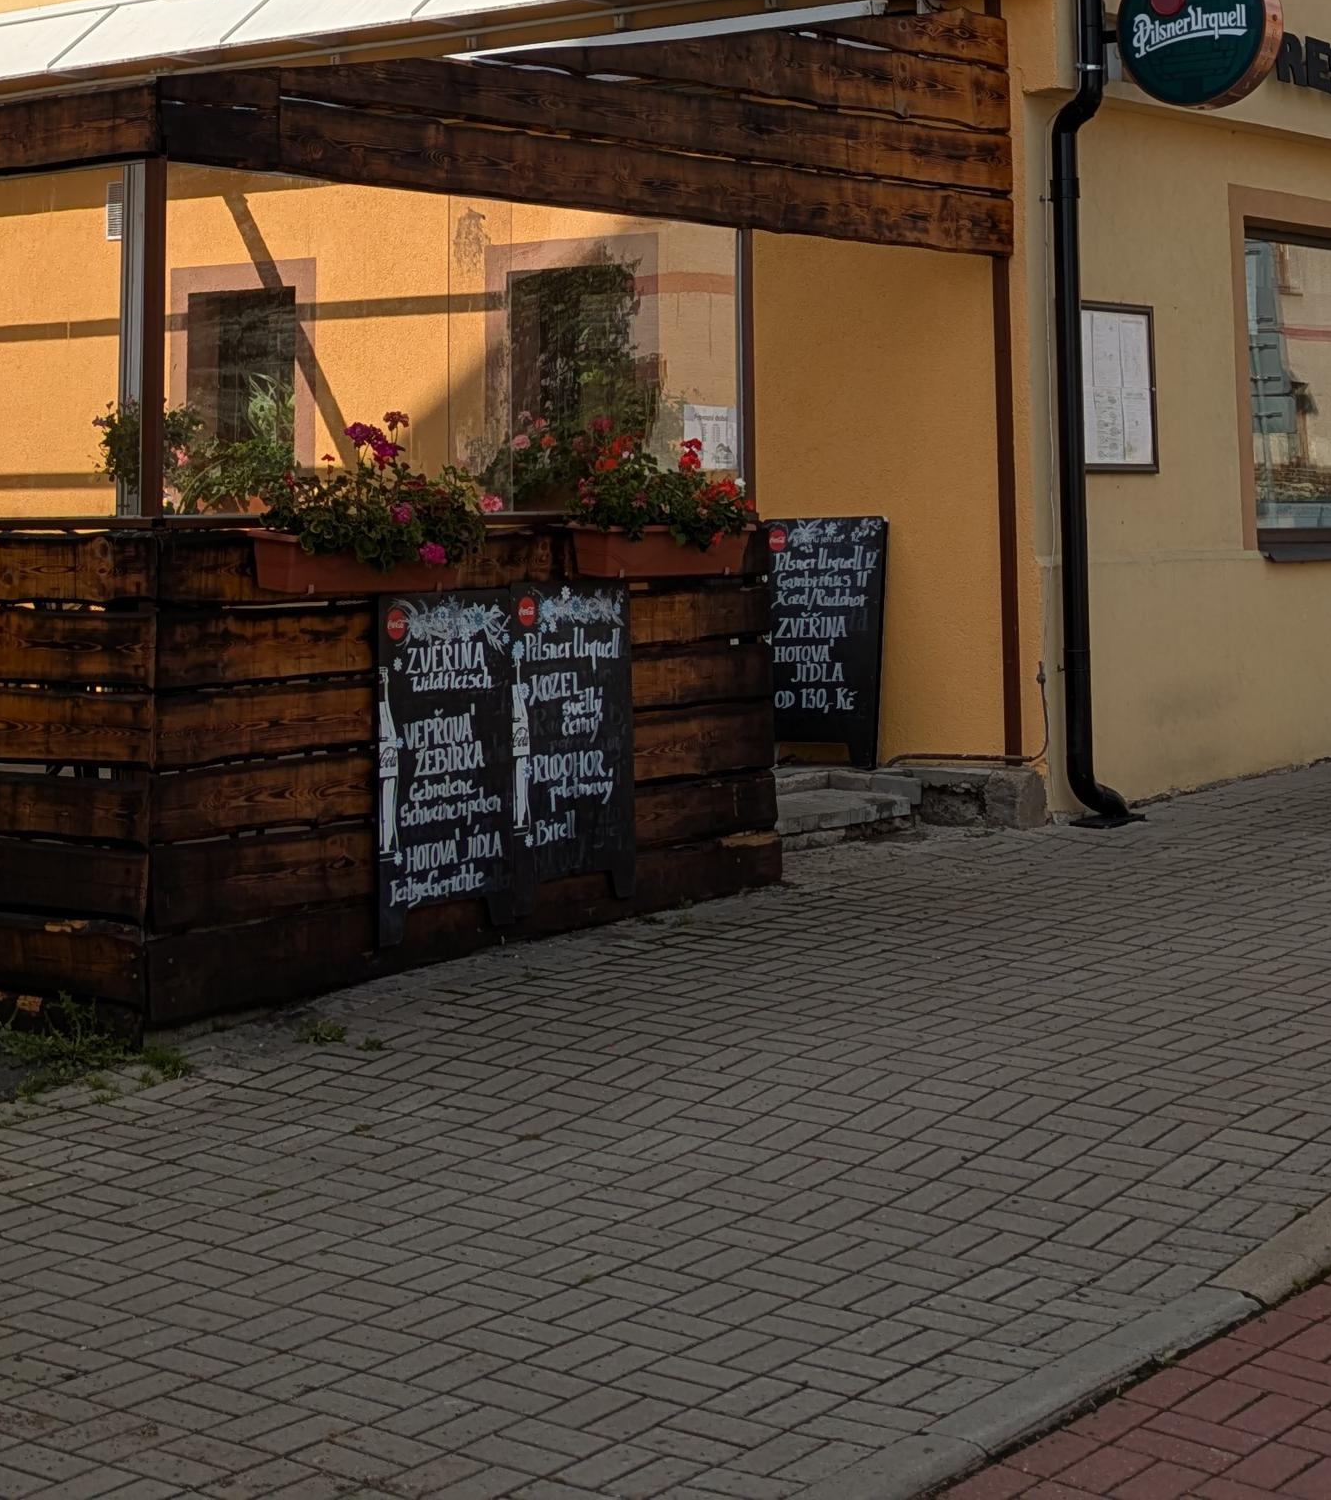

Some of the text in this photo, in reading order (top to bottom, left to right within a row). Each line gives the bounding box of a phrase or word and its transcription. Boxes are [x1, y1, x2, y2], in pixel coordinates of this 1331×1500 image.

[1132, 3, 1247, 59] Pilsner Urquell
[772, 550, 817, 573] Pilsner
[818, 545, 864, 572] Urquell
[776, 571, 852, 590] Gambrinus
[774, 611, 847, 640] ZVĚŘINA
[523, 626, 621, 672] Pilsner Urquell
[410, 666, 494, 692] Wildfleisch
[773, 690, 796, 709] OD
[836, 687, 859, 710] Kč
[403, 703, 476, 750] VEPŘOVÁ
[535, 809, 577, 847] Birell
[404, 824, 503, 874] HOTOVÁ JÍDLA
